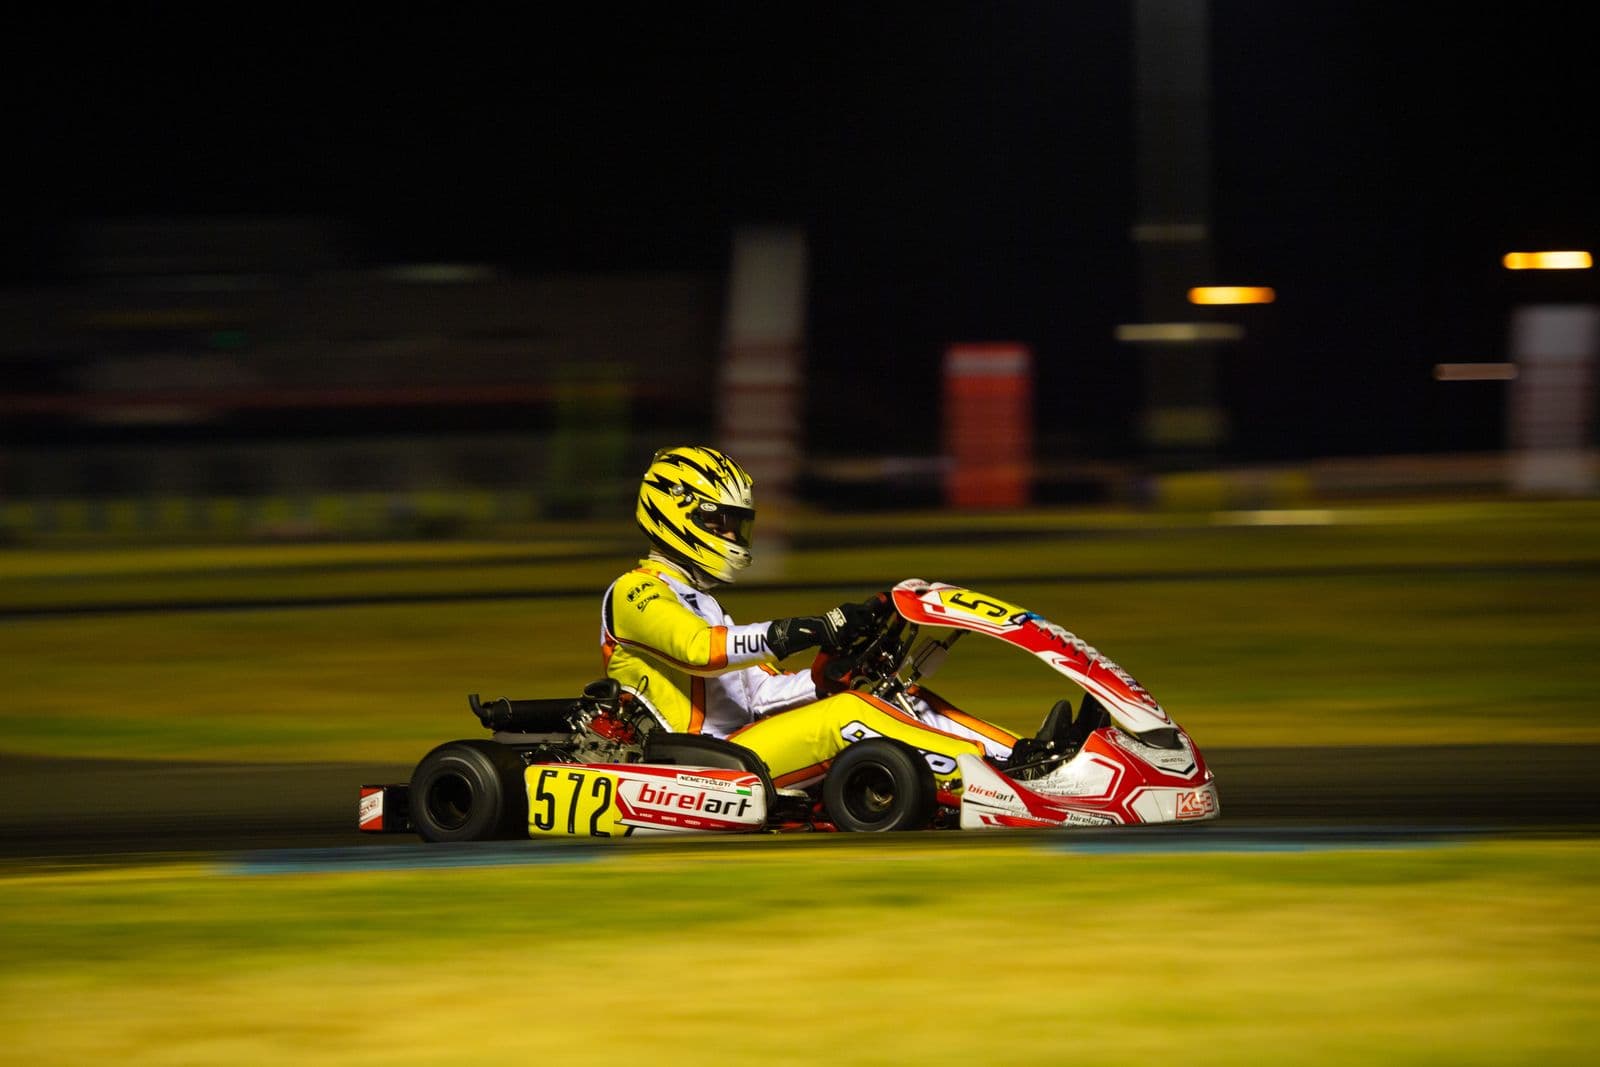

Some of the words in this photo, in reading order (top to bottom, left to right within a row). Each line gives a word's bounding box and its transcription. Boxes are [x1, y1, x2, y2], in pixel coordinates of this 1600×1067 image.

[534, 769, 613, 837] 572
[638, 783, 752, 817] birelart
[967, 784, 1016, 802] birelart
